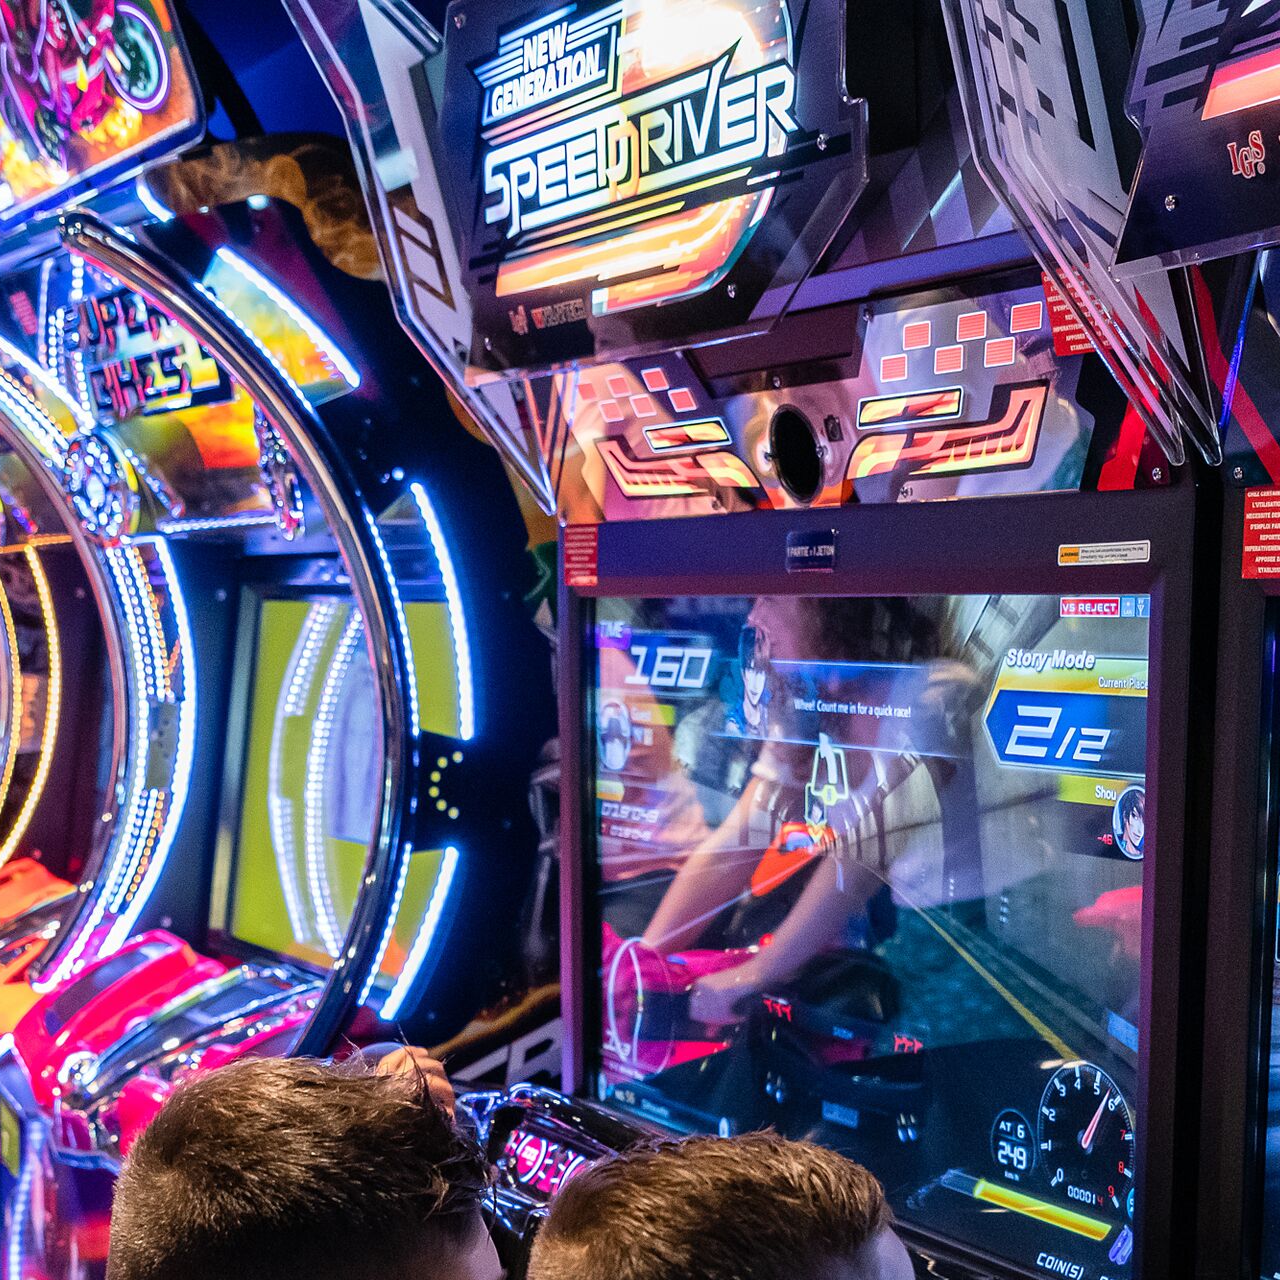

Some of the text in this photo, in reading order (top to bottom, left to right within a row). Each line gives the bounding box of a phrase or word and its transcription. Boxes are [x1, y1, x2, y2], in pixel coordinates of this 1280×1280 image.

[524, 21, 569, 73] NEW
[491, 43, 607, 118] GENERATION
[1061, 602, 1117, 614] VS REJECT
[624, 646, 712, 689] 160
[1005, 649, 1096, 672] Story Mode
[1098, 676, 1127, 690] Current
[816, 700, 837, 713] Count
[837, 703, 849, 714] me
[849, 702, 857, 714] in
[857, 702, 868, 715] for
[873, 704, 893, 719] quick
[893, 706, 911, 718] race!
[1004, 705, 1111, 763] 2/2
[1095, 785, 1117, 801] Shou
[1058, 1085, 1066, 1097] 3
[1074, 1078, 1081, 1090] 4
[1093, 1083, 1101, 1095] 5
[1108, 1099, 1116, 1111] 6
[1048, 1109, 1056, 1121] 2
[999, 1121, 1025, 1139] AT 6
[1120, 1129, 1127, 1141] 7
[997, 1141, 1027, 1170] 249
[1118, 1161, 1125, 1173] 8
[1056, 1168, 1064, 1182] 0
[1107, 1185, 1115, 1197] 9
[1036, 1252, 1085, 1280] COIN(S)
